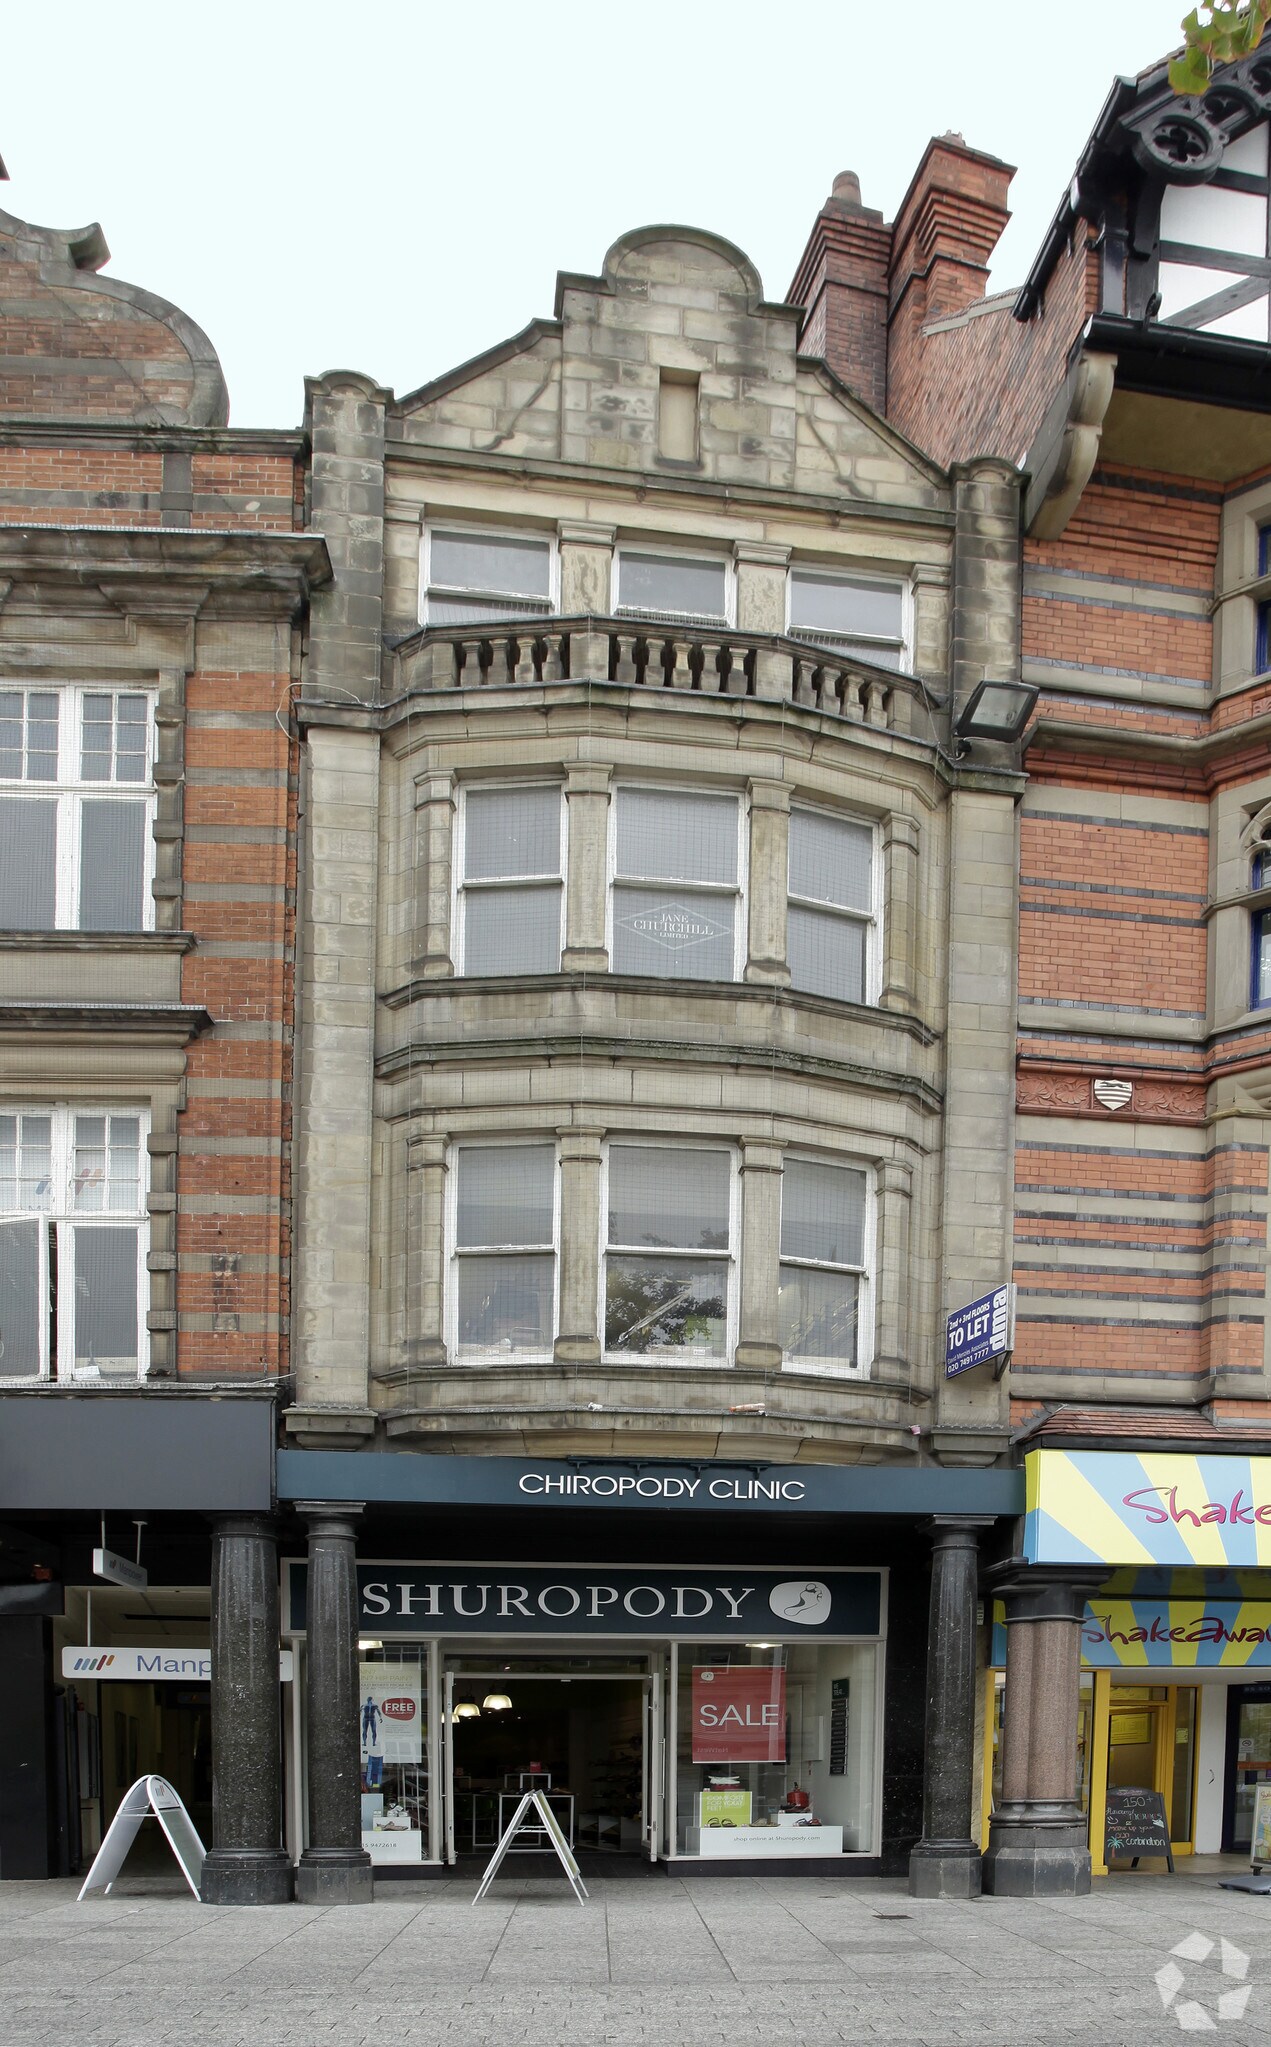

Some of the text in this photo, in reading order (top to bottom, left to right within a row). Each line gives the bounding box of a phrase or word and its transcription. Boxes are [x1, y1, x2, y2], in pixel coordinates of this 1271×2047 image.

[633, 920, 714, 936] CHURCHILL
[660, 914, 689, 923] JANE
[659, 931, 689, 939] LIMITED
[971, 1301, 990, 1319] FLOORS
[949, 1314, 990, 1350] TO LET
[947, 1347, 989, 1373] 020 7491 7777
[518, 1473, 806, 1500] CHIROPODY CLINIC
[362, 1583, 756, 1619] SHUROPODY
[136, 1655, 211, 1677] Manp
[385, 1702, 414, 1712] FREE
[699, 1703, 779, 1727] SALE
